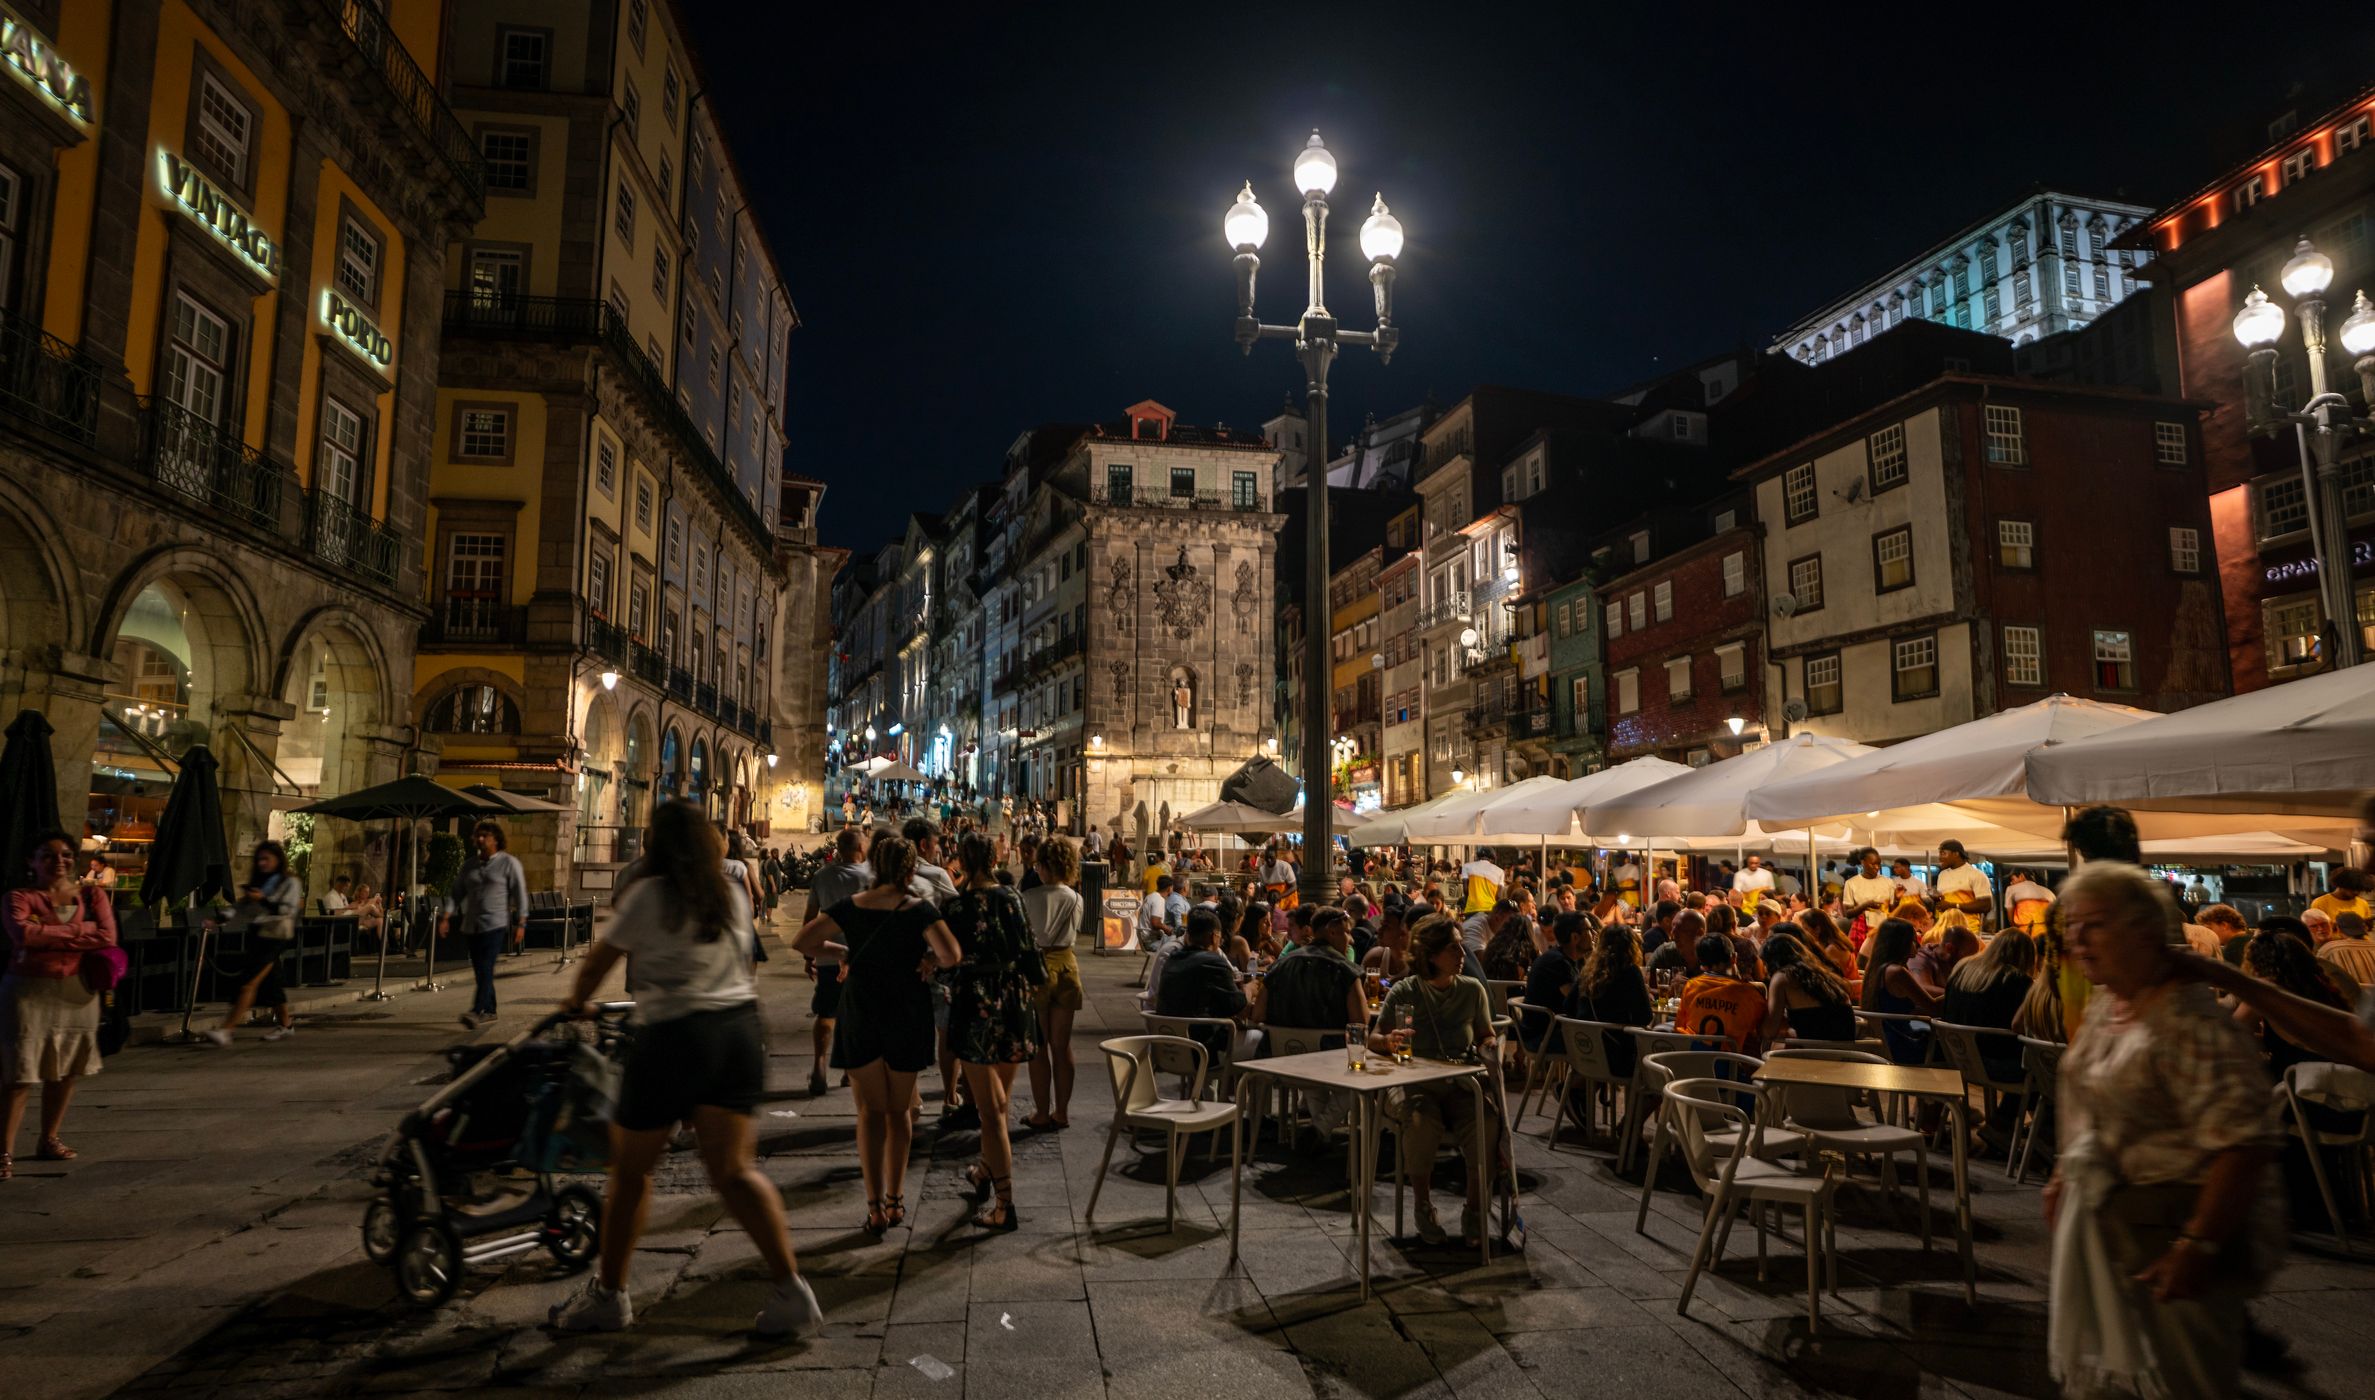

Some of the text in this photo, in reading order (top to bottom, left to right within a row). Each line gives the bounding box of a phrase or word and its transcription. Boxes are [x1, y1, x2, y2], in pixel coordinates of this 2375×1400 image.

[2, 20, 393, 366] ANA VINTAGE PORTO
